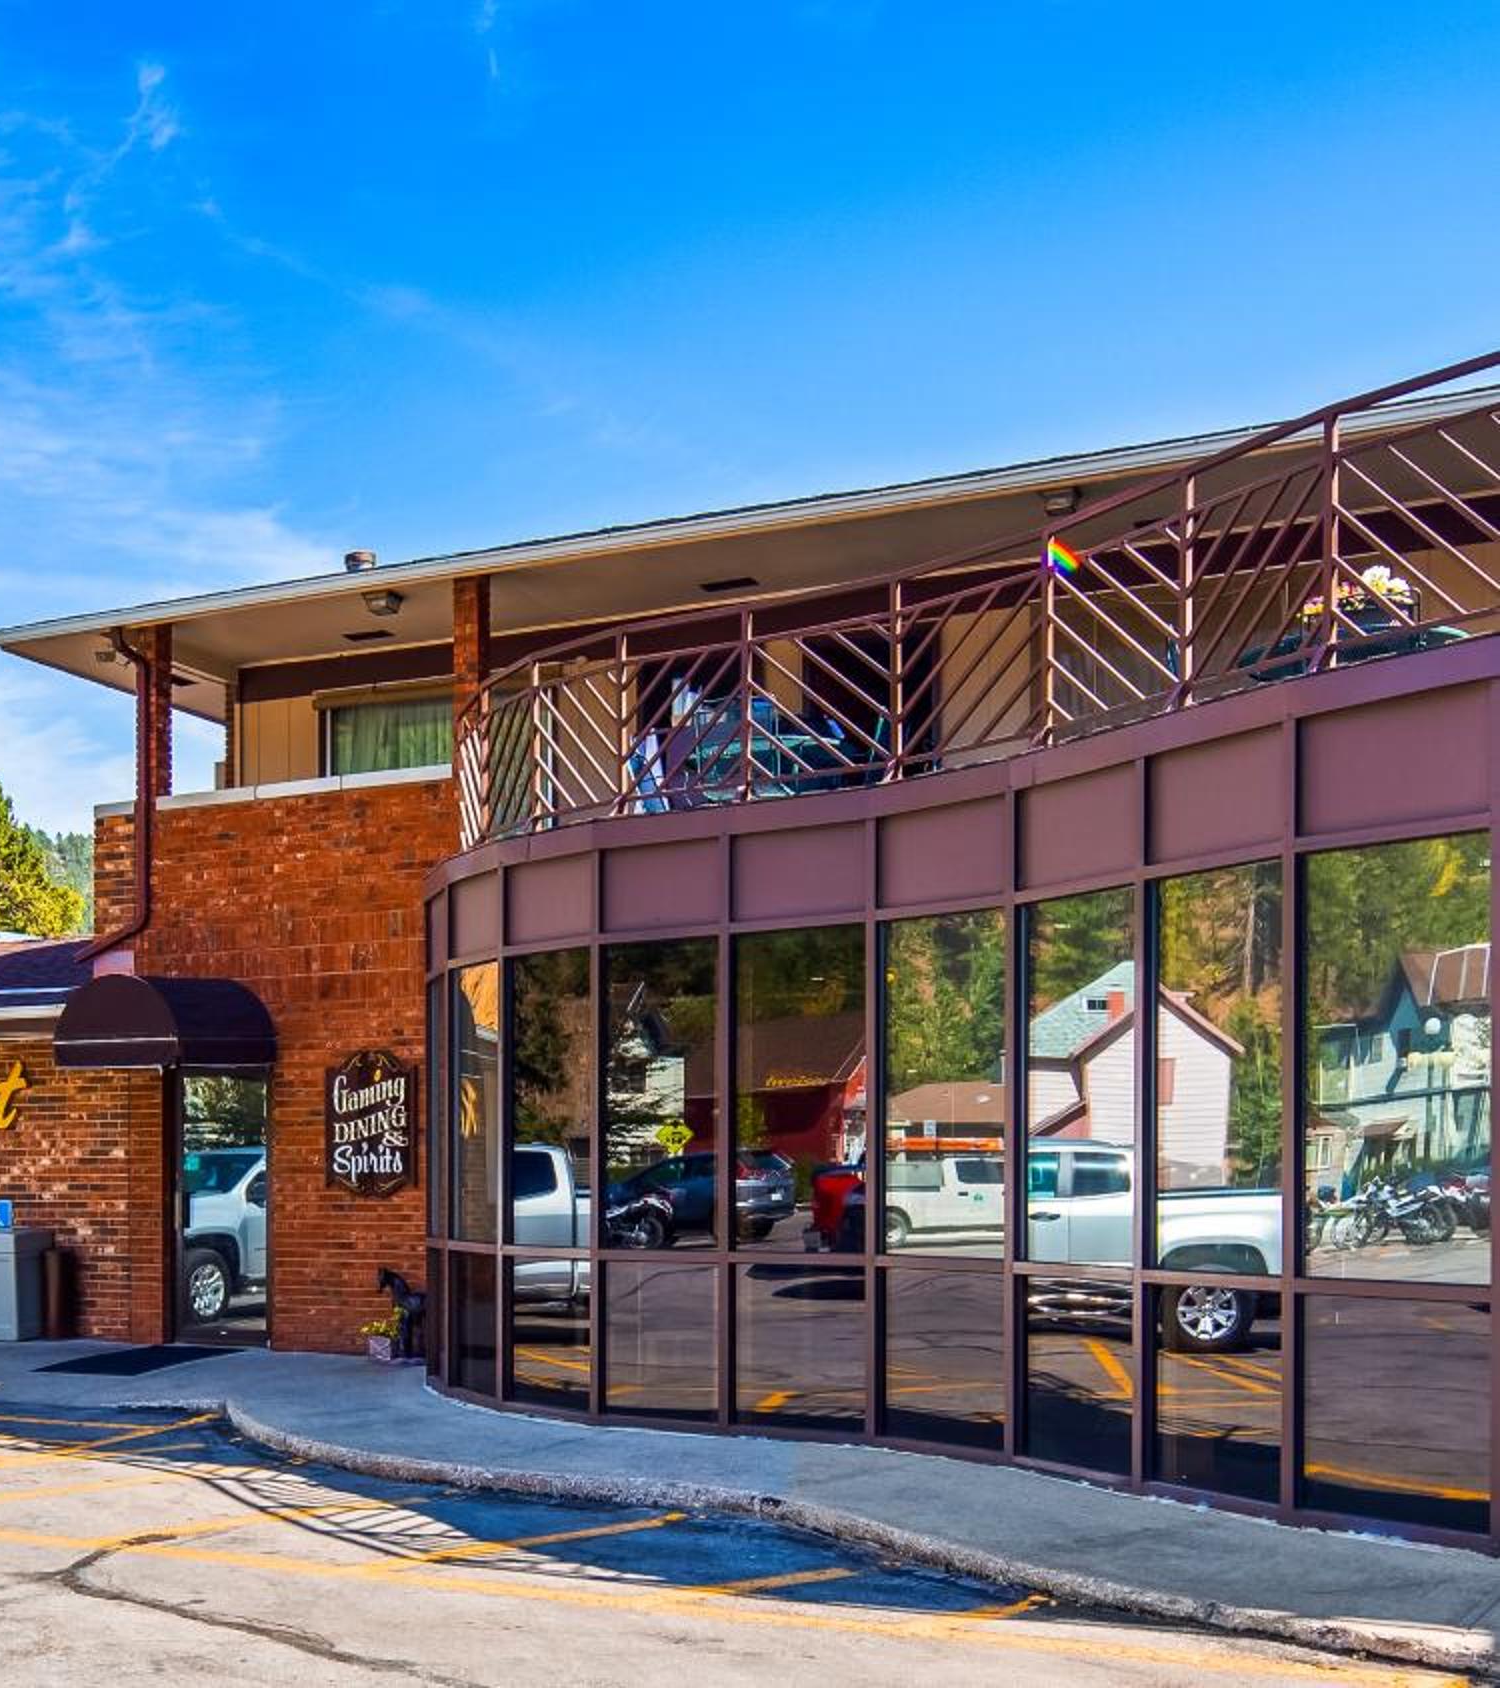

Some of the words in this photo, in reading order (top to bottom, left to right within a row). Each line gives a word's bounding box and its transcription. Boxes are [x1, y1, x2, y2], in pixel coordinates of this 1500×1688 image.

[332, 1074, 406, 1115] Gaming
[333, 1105, 407, 1143] DINING
[381, 1129, 409, 1147] &
[332, 1142, 403, 1186] Spirits
